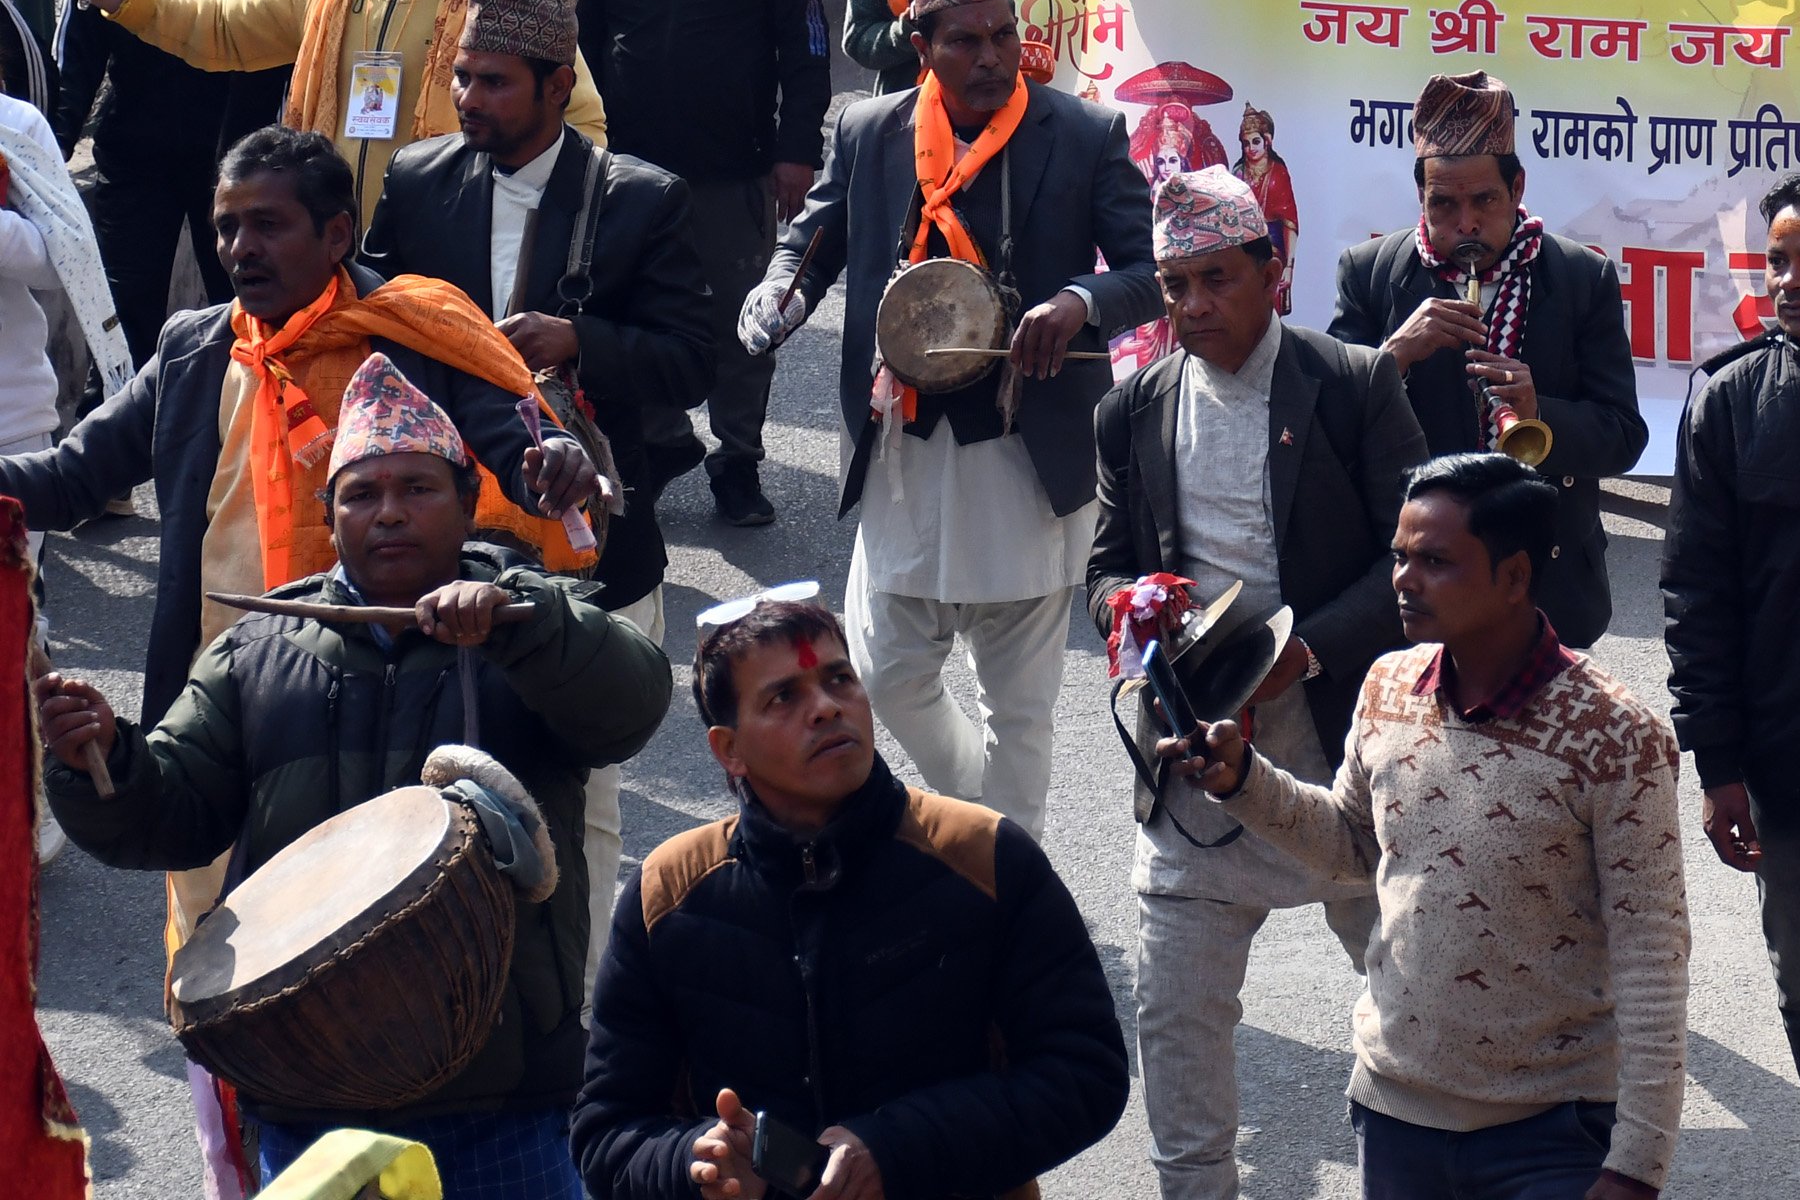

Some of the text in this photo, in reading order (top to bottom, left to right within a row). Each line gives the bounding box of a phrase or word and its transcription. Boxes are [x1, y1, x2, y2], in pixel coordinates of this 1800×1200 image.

[1300, 1, 1409, 48] जय
[1526, 15, 1648, 62] राम
[1668, 23, 1791, 68] जय
[1531, 96, 1639, 163] रामको
[1648, 115, 1717, 175] प्राण
